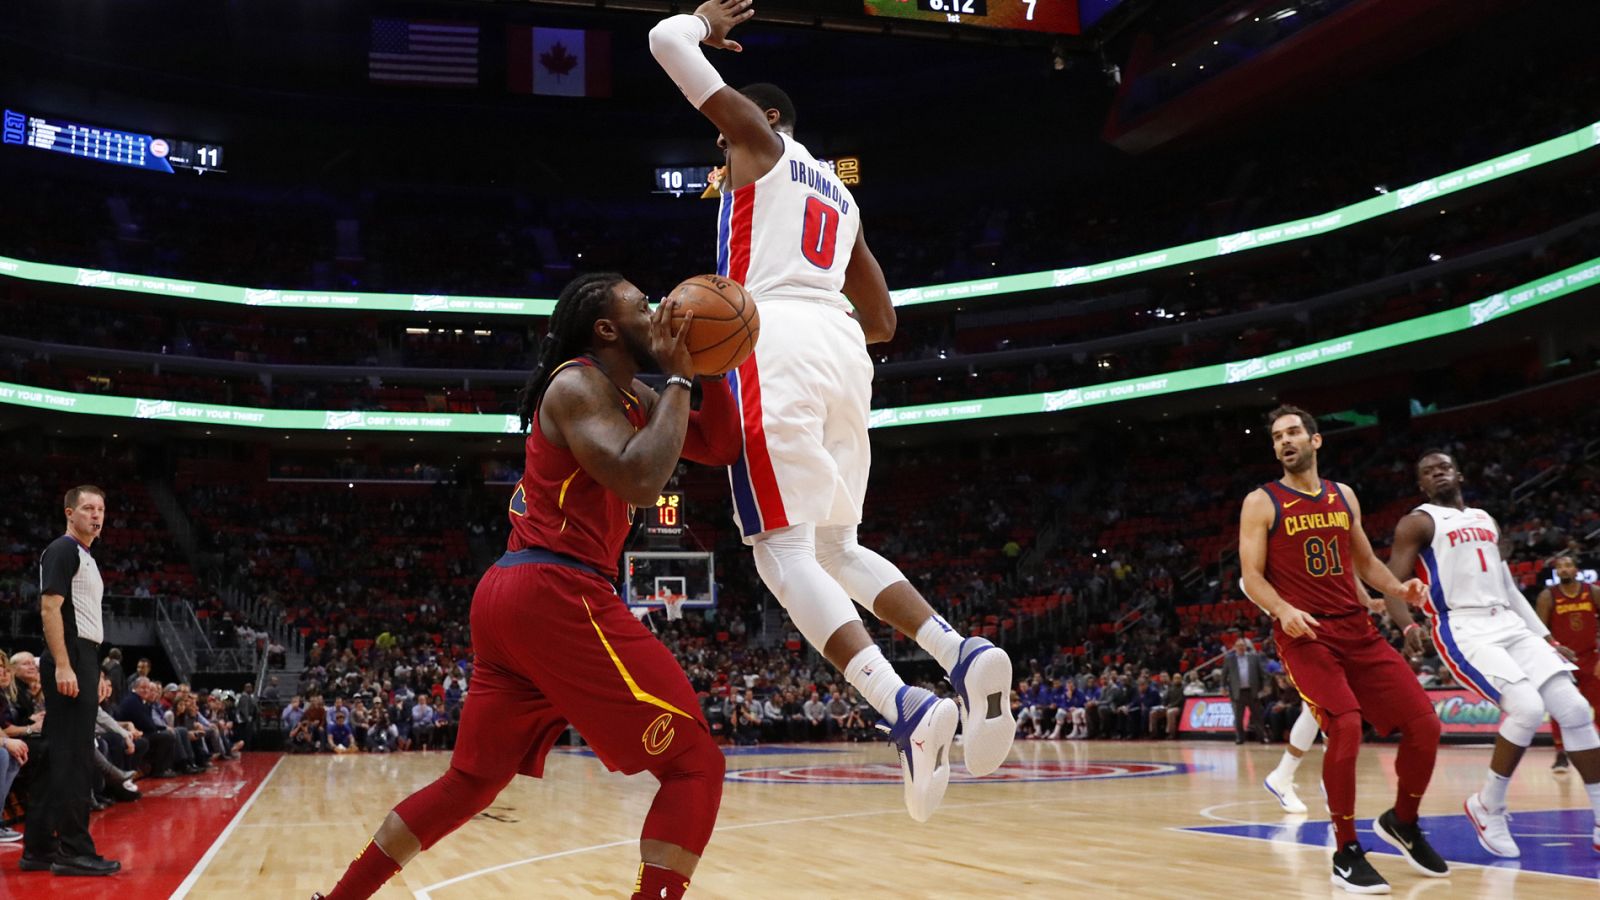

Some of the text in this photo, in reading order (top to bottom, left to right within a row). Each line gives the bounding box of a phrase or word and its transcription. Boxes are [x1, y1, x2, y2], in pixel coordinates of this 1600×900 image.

[946, 13, 960, 22] 1st
[1022, 0, 1037, 20] 7
[4, 109, 25, 145] DET
[197, 148, 217, 166] 11
[661, 171, 682, 188] 10
[801, 195, 840, 270] 0
[17, 390, 43, 401] YOUR
[44, 395, 77, 406] THIRST
[1083, 390, 1108, 400] OBEY
[1109, 385, 1134, 396] YOUR
[1136, 378, 1168, 392] THIRST
[178, 407, 204, 416] OBEY
[205, 409, 231, 419] YOUR
[233, 411, 265, 422] THIRST
[899, 410, 923, 420] OBEY
[924, 407, 949, 417] YOUR
[951, 404, 982, 416] THIRST
[367, 416, 391, 426] OBEY
[393, 417, 419, 426] YOUR
[420, 418, 453, 427] THIRST
[660, 507, 676, 525] 10
[1285, 511, 1350, 536] CLEVELAND
[1303, 535, 1344, 577] 81
[1476, 548, 1488, 573] 1
